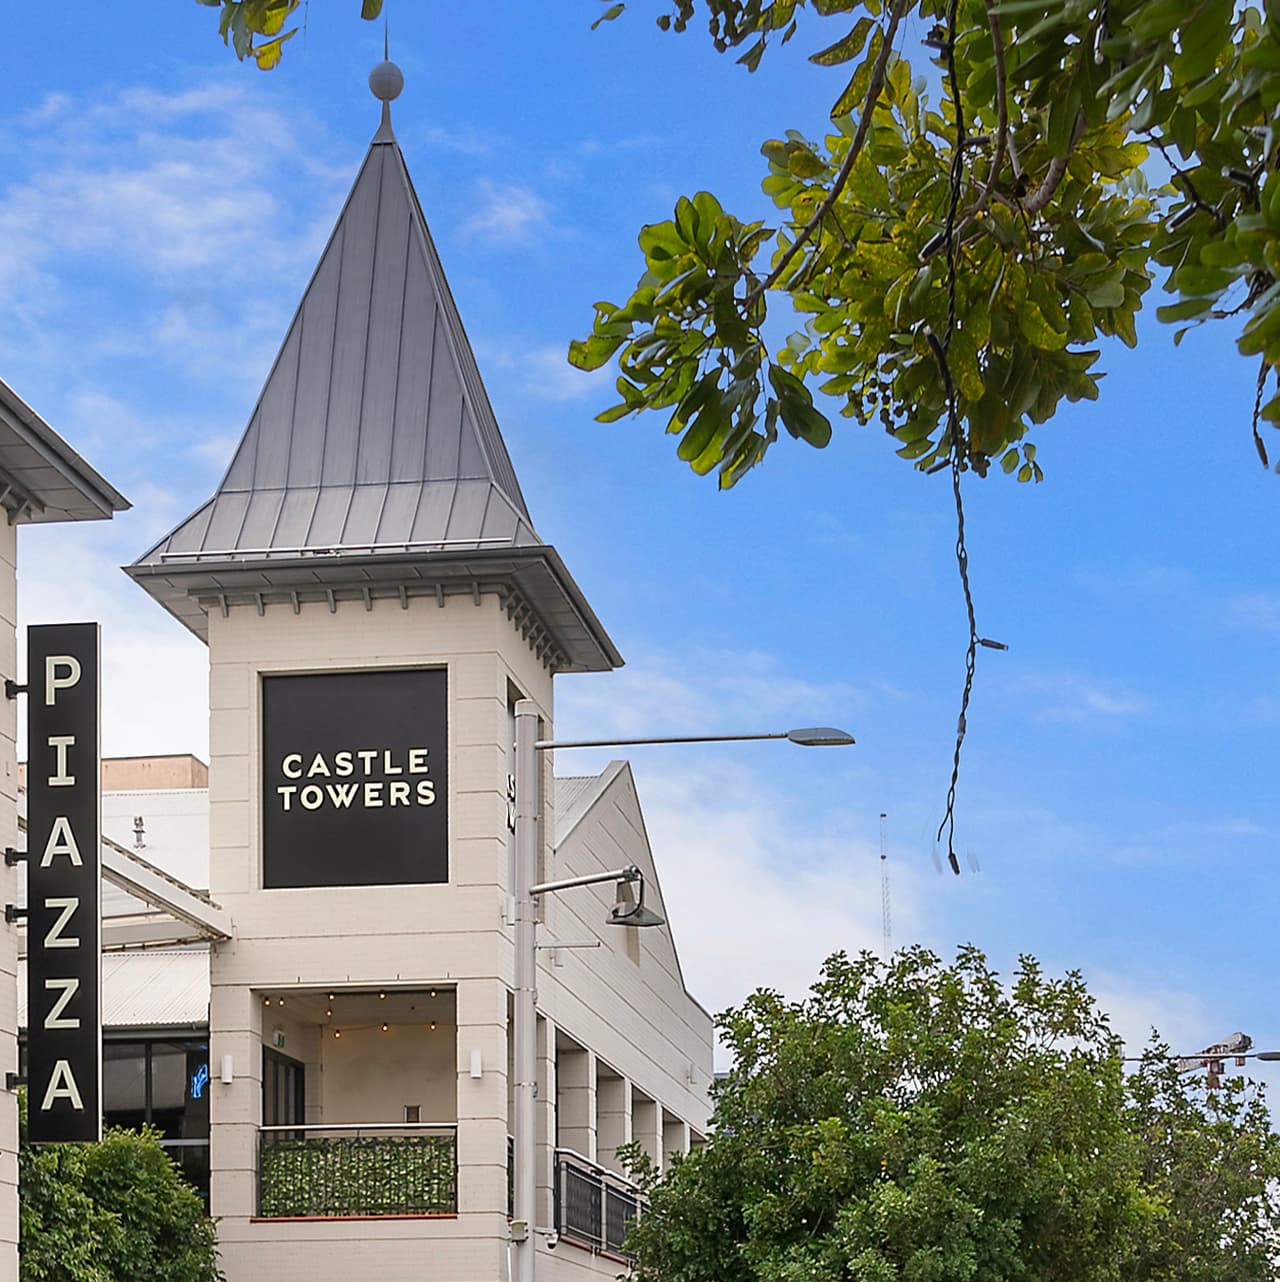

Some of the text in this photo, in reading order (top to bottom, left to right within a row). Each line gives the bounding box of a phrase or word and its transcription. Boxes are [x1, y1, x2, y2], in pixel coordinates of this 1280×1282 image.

[282, 749, 428, 779] CASTLE
[277, 780, 436, 811] TOWERS
[41, 655, 83, 1111] PIAZZA
